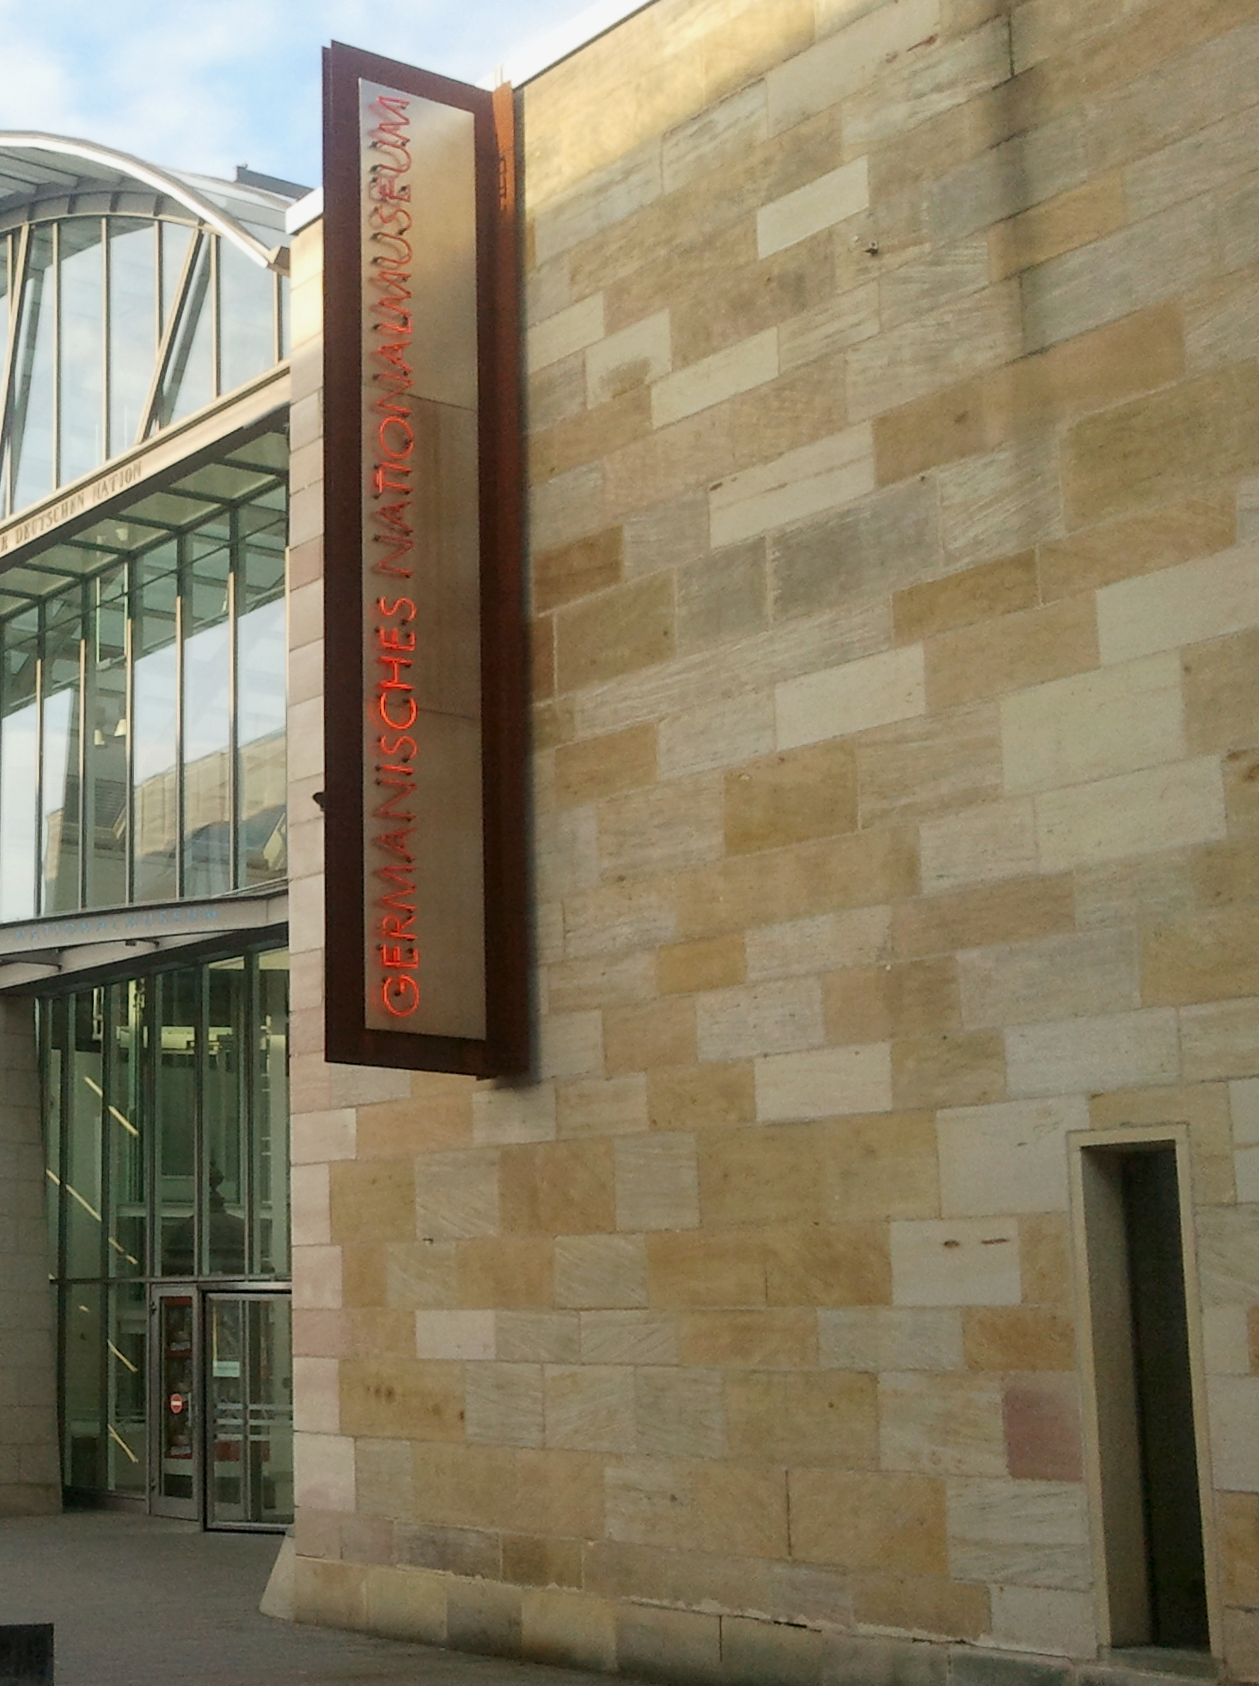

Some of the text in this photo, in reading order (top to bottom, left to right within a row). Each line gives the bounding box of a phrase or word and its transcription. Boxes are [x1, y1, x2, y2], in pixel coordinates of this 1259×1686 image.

[15, 491, 84, 545] DEUTSCHEN
[92, 460, 141, 503] NATION
[376, 95, 420, 1018] GERMANISCHES NATIONALMUSEUM
[15, 908, 218, 941] NATIONALMUSEUM
